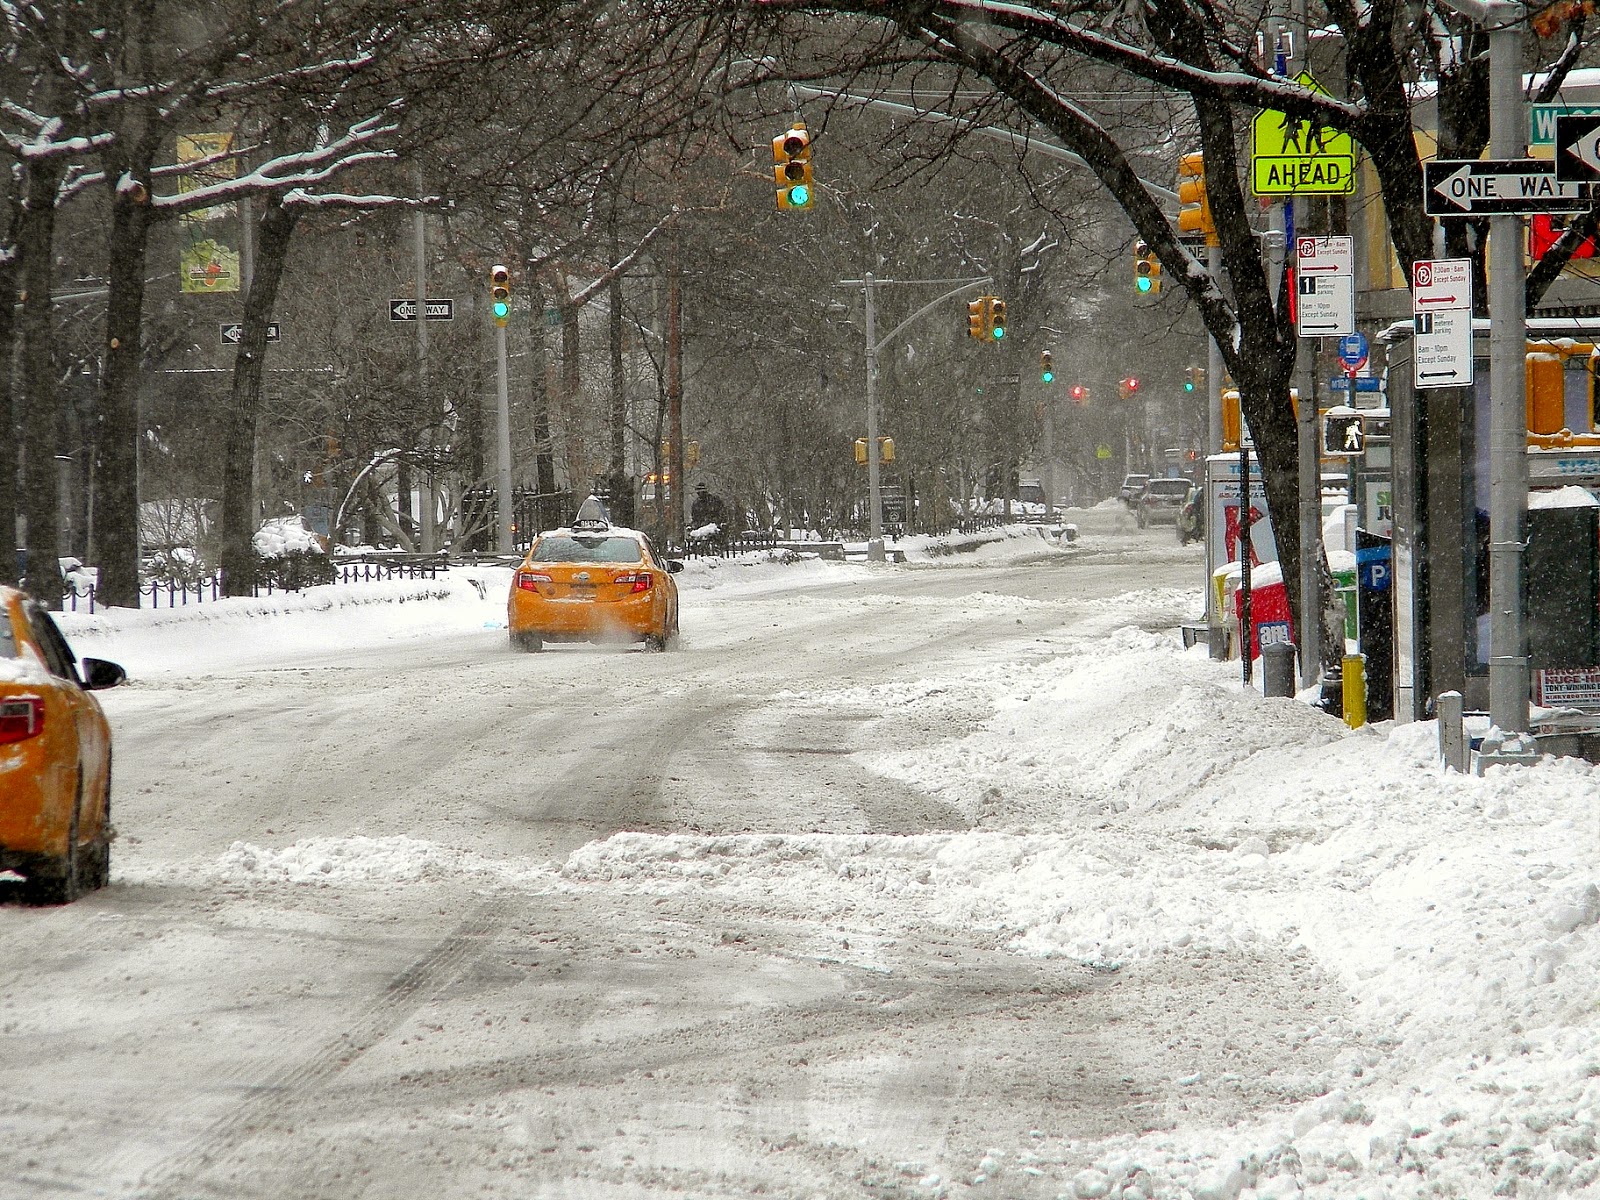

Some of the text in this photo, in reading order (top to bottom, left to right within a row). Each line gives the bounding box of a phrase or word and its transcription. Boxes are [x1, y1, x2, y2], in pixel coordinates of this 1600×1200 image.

[1268, 163, 1340, 185] AHEAD
[1452, 176, 1565, 197] ONE WAY
[1187, 246, 1205, 258] NE
[426, 306, 445, 314] WAY
[1418, 355, 1456, 364] Except Sunday
[1371, 565, 1386, 587] P
